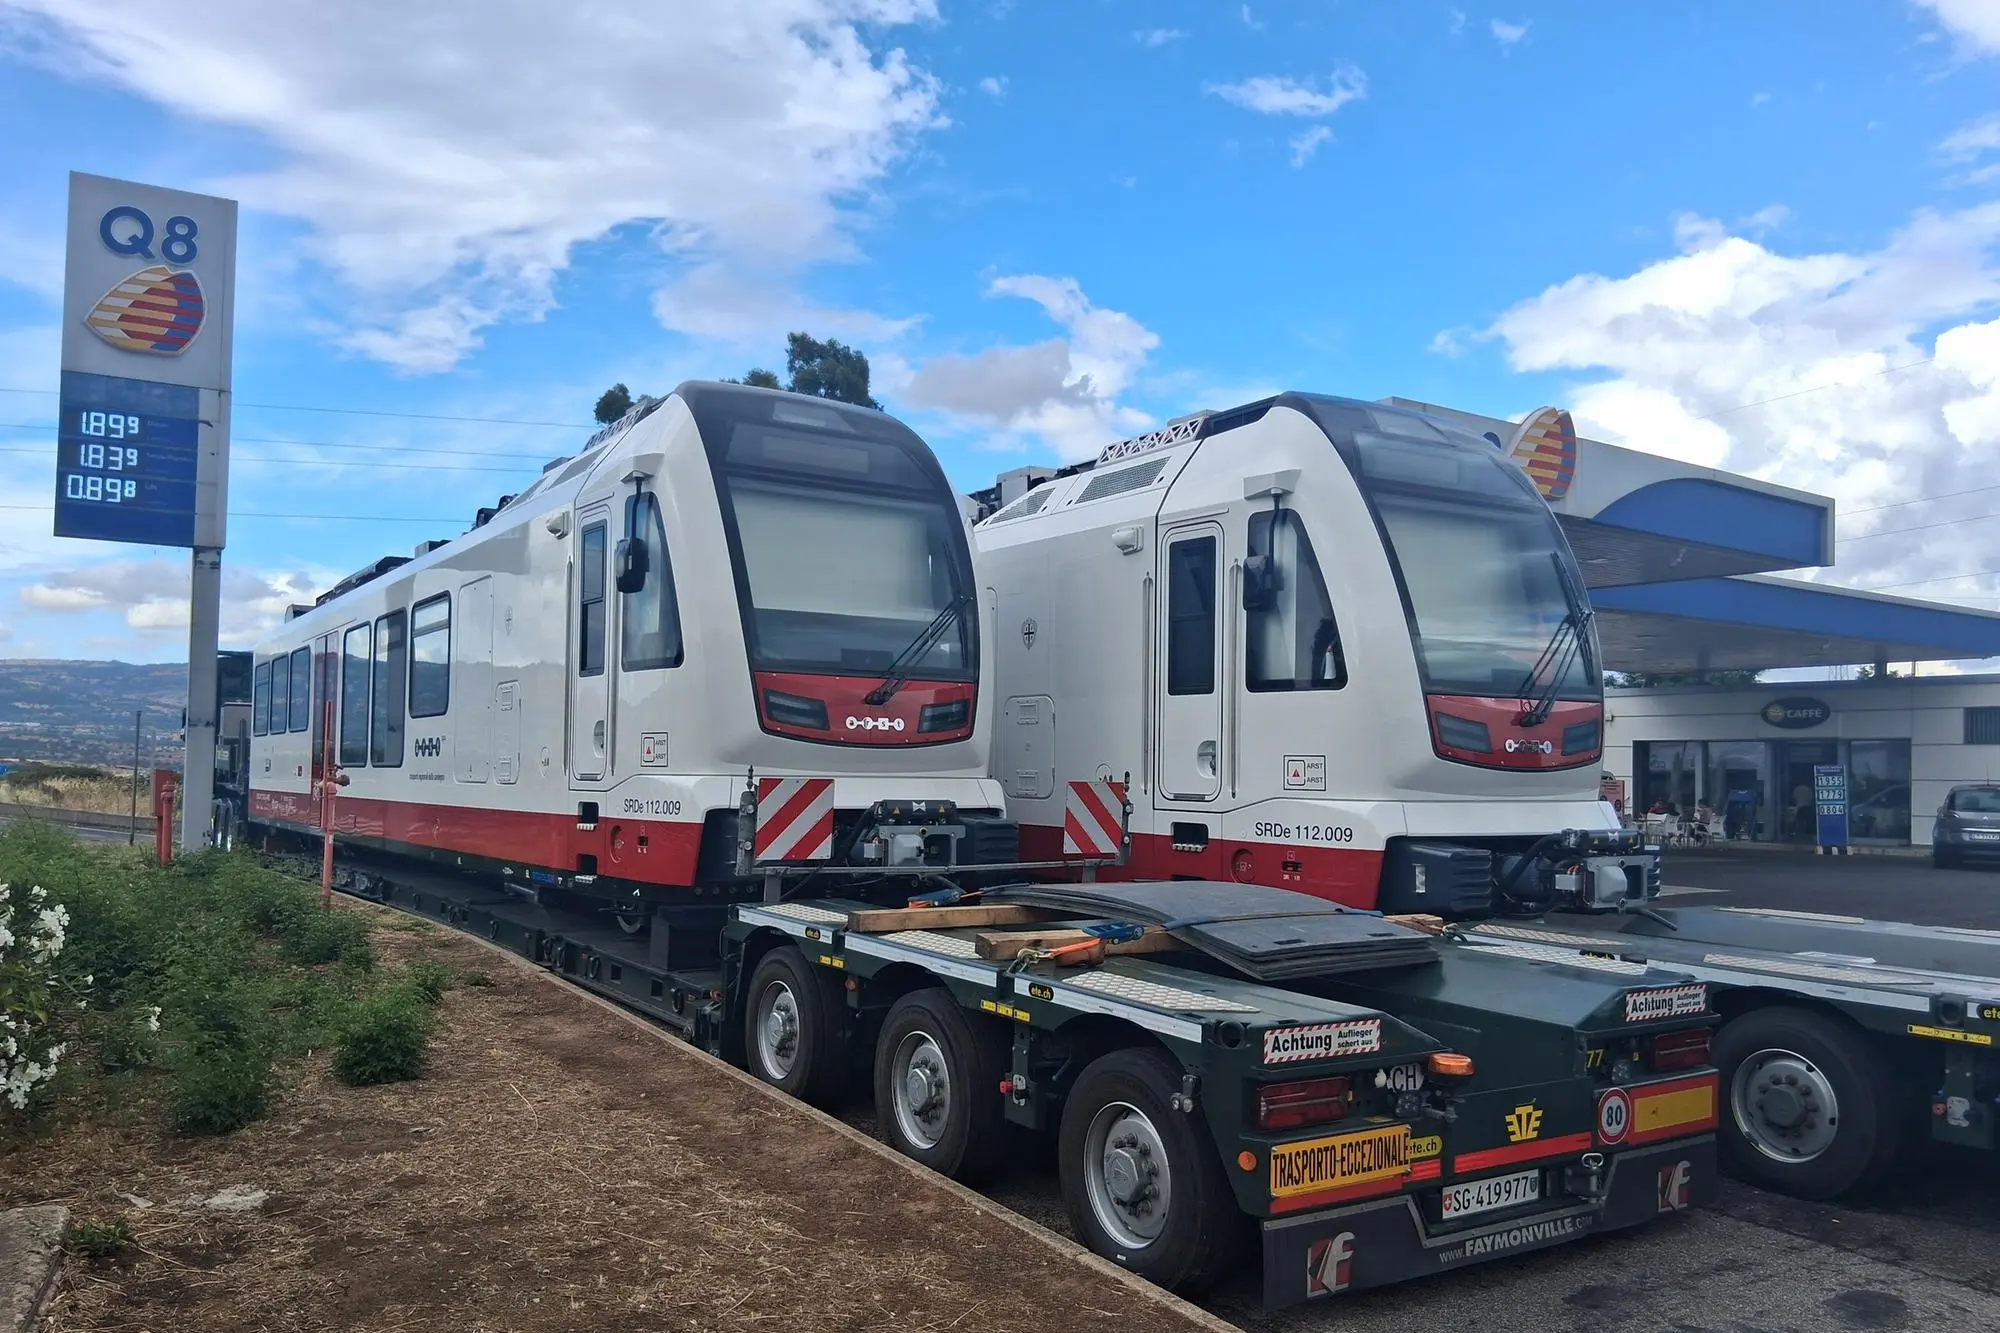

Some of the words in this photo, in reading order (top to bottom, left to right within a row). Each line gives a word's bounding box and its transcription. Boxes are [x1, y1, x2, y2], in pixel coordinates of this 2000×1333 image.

[100, 206, 198, 264] Q8
[81, 411, 139, 439] 1.899
[80, 444, 138, 471] 1.839
[67, 474, 136, 503] 0.898
[624, 798, 644, 814] SRDe
[645, 800, 681, 816] 112.009
[1255, 821, 1291, 839] SRDe
[1295, 825, 1353, 843] 112.009
[1631, 996, 1674, 1014] Achtung
[1271, 1033, 1332, 1053] Achtung
[1337, 1028, 1373, 1039] Auflieger
[1337, 1040, 1360, 1049] schert
[1391, 1063, 1417, 1093] CH
[1606, 1105, 1623, 1127] 80
[1272, 1144, 1337, 1189] TRASPORTO
[1340, 1132, 1410, 1178] ECCEZIONALE
